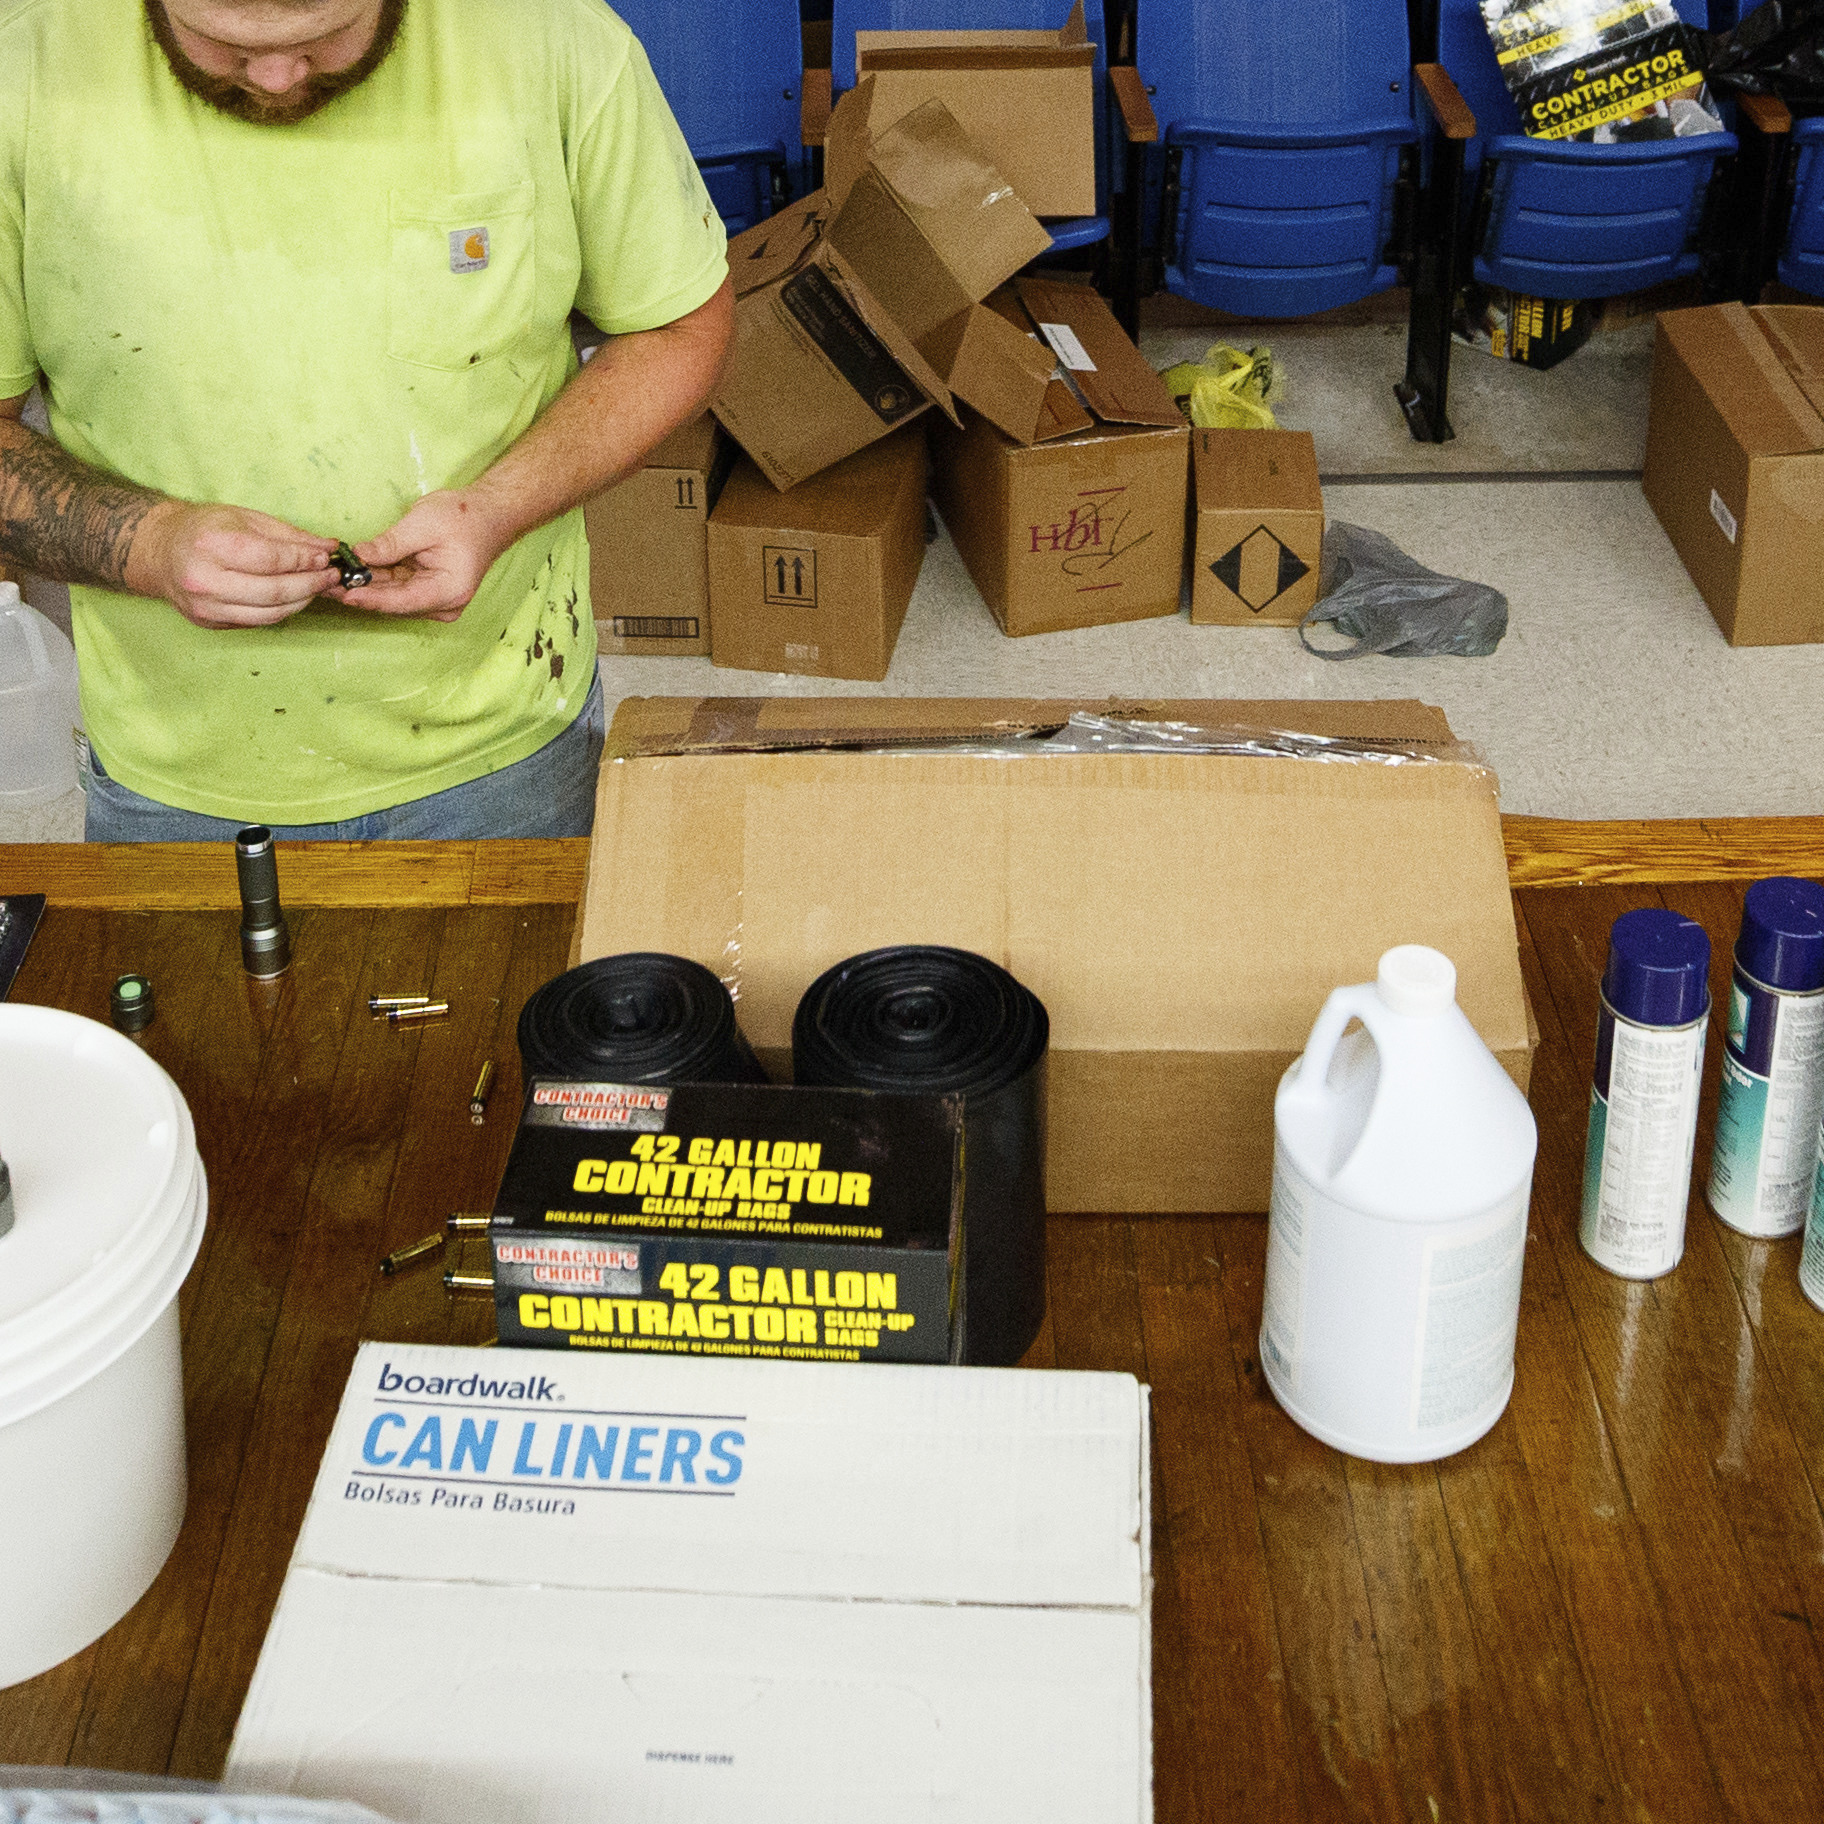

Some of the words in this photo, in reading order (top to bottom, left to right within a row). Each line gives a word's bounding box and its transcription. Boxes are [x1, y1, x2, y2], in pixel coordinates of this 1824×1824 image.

[1531, 49, 1687, 121] CONTRACTOR
[1549, 115, 1596, 139] HEAVY
[1599, 99, 1636, 121] DUTY
[534, 1089, 669, 1111] CONTRACTOR'S
[563, 1107, 631, 1123] CHOICE
[631, 1134, 682, 1164] 42
[687, 1137, 823, 1171] GALLON
[573, 1158, 872, 1208] CONTRACTOR
[642, 1196, 733, 1218] CLEAN-UP
[736, 1201, 793, 1221] BAGS
[545, 1210, 592, 1225] BOLSAS
[593, 1212, 609, 1225] DE
[611, 1213, 667, 1228] LIMPIEZA
[668, 1216, 685, 1228] DE
[686, 1217, 700, 1230] 42
[701, 1218, 756, 1232] GALONES
[757, 1220, 792, 1234] PARA
[792, 1222, 884, 1239] CONTRATISTAS
[497, 1244, 639, 1270] CONTRACTOR'S
[533, 1266, 603, 1284] CHOICE
[659, 1262, 721, 1301] 42
[729, 1266, 898, 1310] GALLON
[518, 1293, 818, 1344] CONTRACTOR
[824, 1310, 916, 1332] CLEAN-UP
[569, 1334, 610, 1348] BOLSAS
[611, 1336, 626, 1348] DE
[626, 1337, 675, 1352] LIMPIEZA
[676, 1340, 690, 1353] DE
[703, 1342, 752, 1357] GALONES
[752, 1344, 782, 1358] PARA
[783, 1346, 861, 1363] CONTRATISTAS
[825, 1329, 879, 1348] BAGS
[362, 1411, 500, 1475] CAN
[512, 1419, 747, 1486] LINERS
[343, 1480, 423, 1507] Bolsas
[430, 1486, 485, 1511] Para
[492, 1492, 577, 1517] Basura
